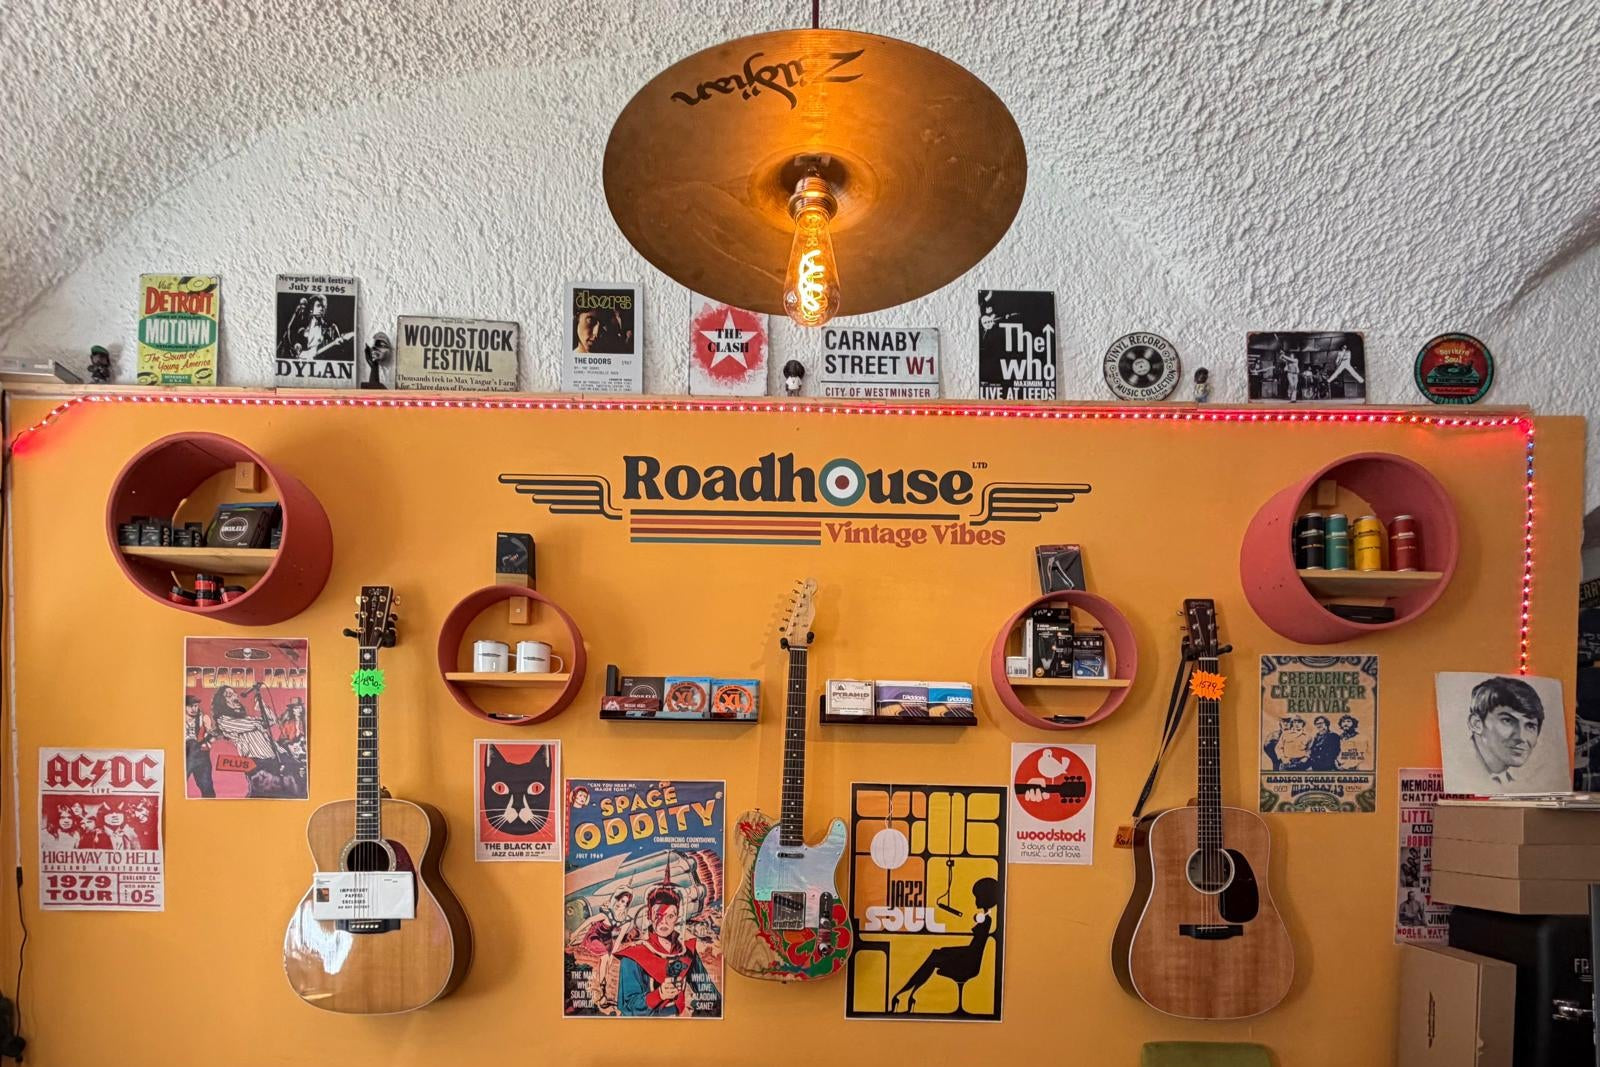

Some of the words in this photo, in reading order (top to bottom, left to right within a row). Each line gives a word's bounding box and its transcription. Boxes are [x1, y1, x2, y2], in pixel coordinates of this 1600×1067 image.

[279, 274, 309, 283] Newport
[289, 283, 309, 292] July
[145, 286, 213, 314] DETROIT
[576, 290, 632, 310] doors
[145, 319, 210, 344] MOTOWN
[404, 325, 513, 351] WOODSTOCK
[716, 329, 742, 339] THE
[999, 323, 1045, 352] The
[707, 342, 749, 352] CLASH
[825, 330, 920, 351] CARNABY
[1107, 340, 1128, 363] VINYL
[1128, 336, 1166, 350] RECORD
[144, 353, 160, 363] The
[163, 352, 186, 361] Sound
[423, 348, 493, 372] FESTIVAL
[825, 354, 901, 375] STREET
[906, 356, 935, 375] W1
[158, 362, 180, 372] Young
[181, 359, 211, 370] America
[276, 360, 354, 379] DYLAN
[1116, 383, 1138, 397] MUSIC
[1141, 370, 1176, 397] COLLECTION
[825, 387, 846, 396] CITY
[849, 388, 861, 397] OF
[864, 388, 931, 398] WESTMINSTER
[980, 387, 1003, 400] LIVE
[1006, 388, 1020, 400] AT
[1023, 388, 1055, 400] LEEDS
[622, 452, 974, 506] Roadhouse
[825, 521, 927, 548] Vintage
[931, 522, 1006, 545] Vibes
[1278, 671, 1359, 685] CREEDENCE
[1271, 685, 1366, 699] CLEARWATER
[1287, 699, 1350, 713] REVIVAL
[44, 753, 159, 789] AC/DC
[1305, 777, 1335, 785] SQUARE
[600, 786, 678, 816] SPACE
[1402, 811, 1432, 823] LITTL
[575, 800, 716, 850] ODDITY
[1017, 829, 1086, 842] woodstock
[1027, 842, 1045, 851] days
[43, 851, 102, 864] HIGHWAY
[105, 852, 122, 864] TO
[126, 852, 160, 864] HELL
[47, 875, 111, 888] 1979
[46, 890, 112, 901] TOUR
[131, 890, 155, 903] 05
[888, 880, 923, 910] JAZZ
[865, 906, 946, 933] SOUL
[571, 971, 582, 979] THE
[691, 974, 704, 982] WHO
